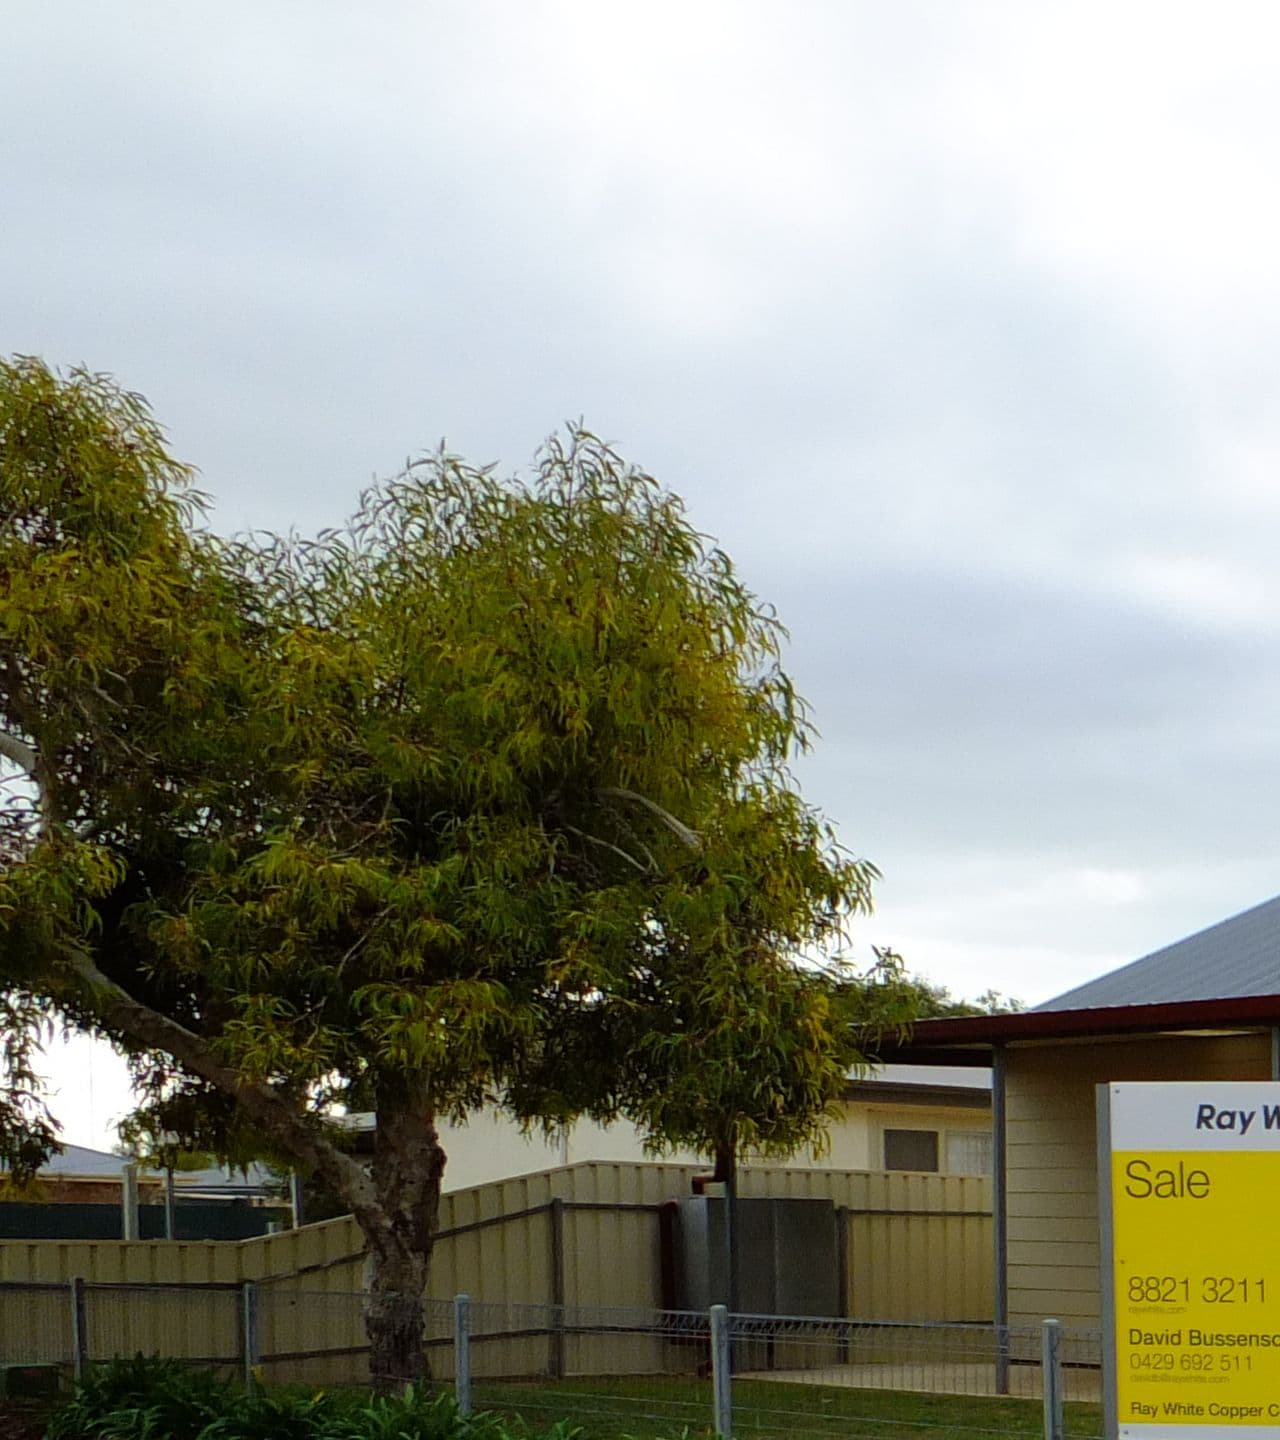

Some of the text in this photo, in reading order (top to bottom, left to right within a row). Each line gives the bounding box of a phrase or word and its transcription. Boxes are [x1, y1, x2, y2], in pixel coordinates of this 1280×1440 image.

[1196, 1104, 1256, 1135] Ray
[1125, 1160, 1210, 1199] Sale
[1128, 1276, 1266, 1303] 8821 3211
[1129, 1329, 1182, 1346] David
[1130, 1353, 1252, 1371] 0429 692 511
[1131, 1402, 1158, 1418] Ray
[1163, 1403, 1204, 1417] White
[1208, 1403, 1263, 1419] Copper
